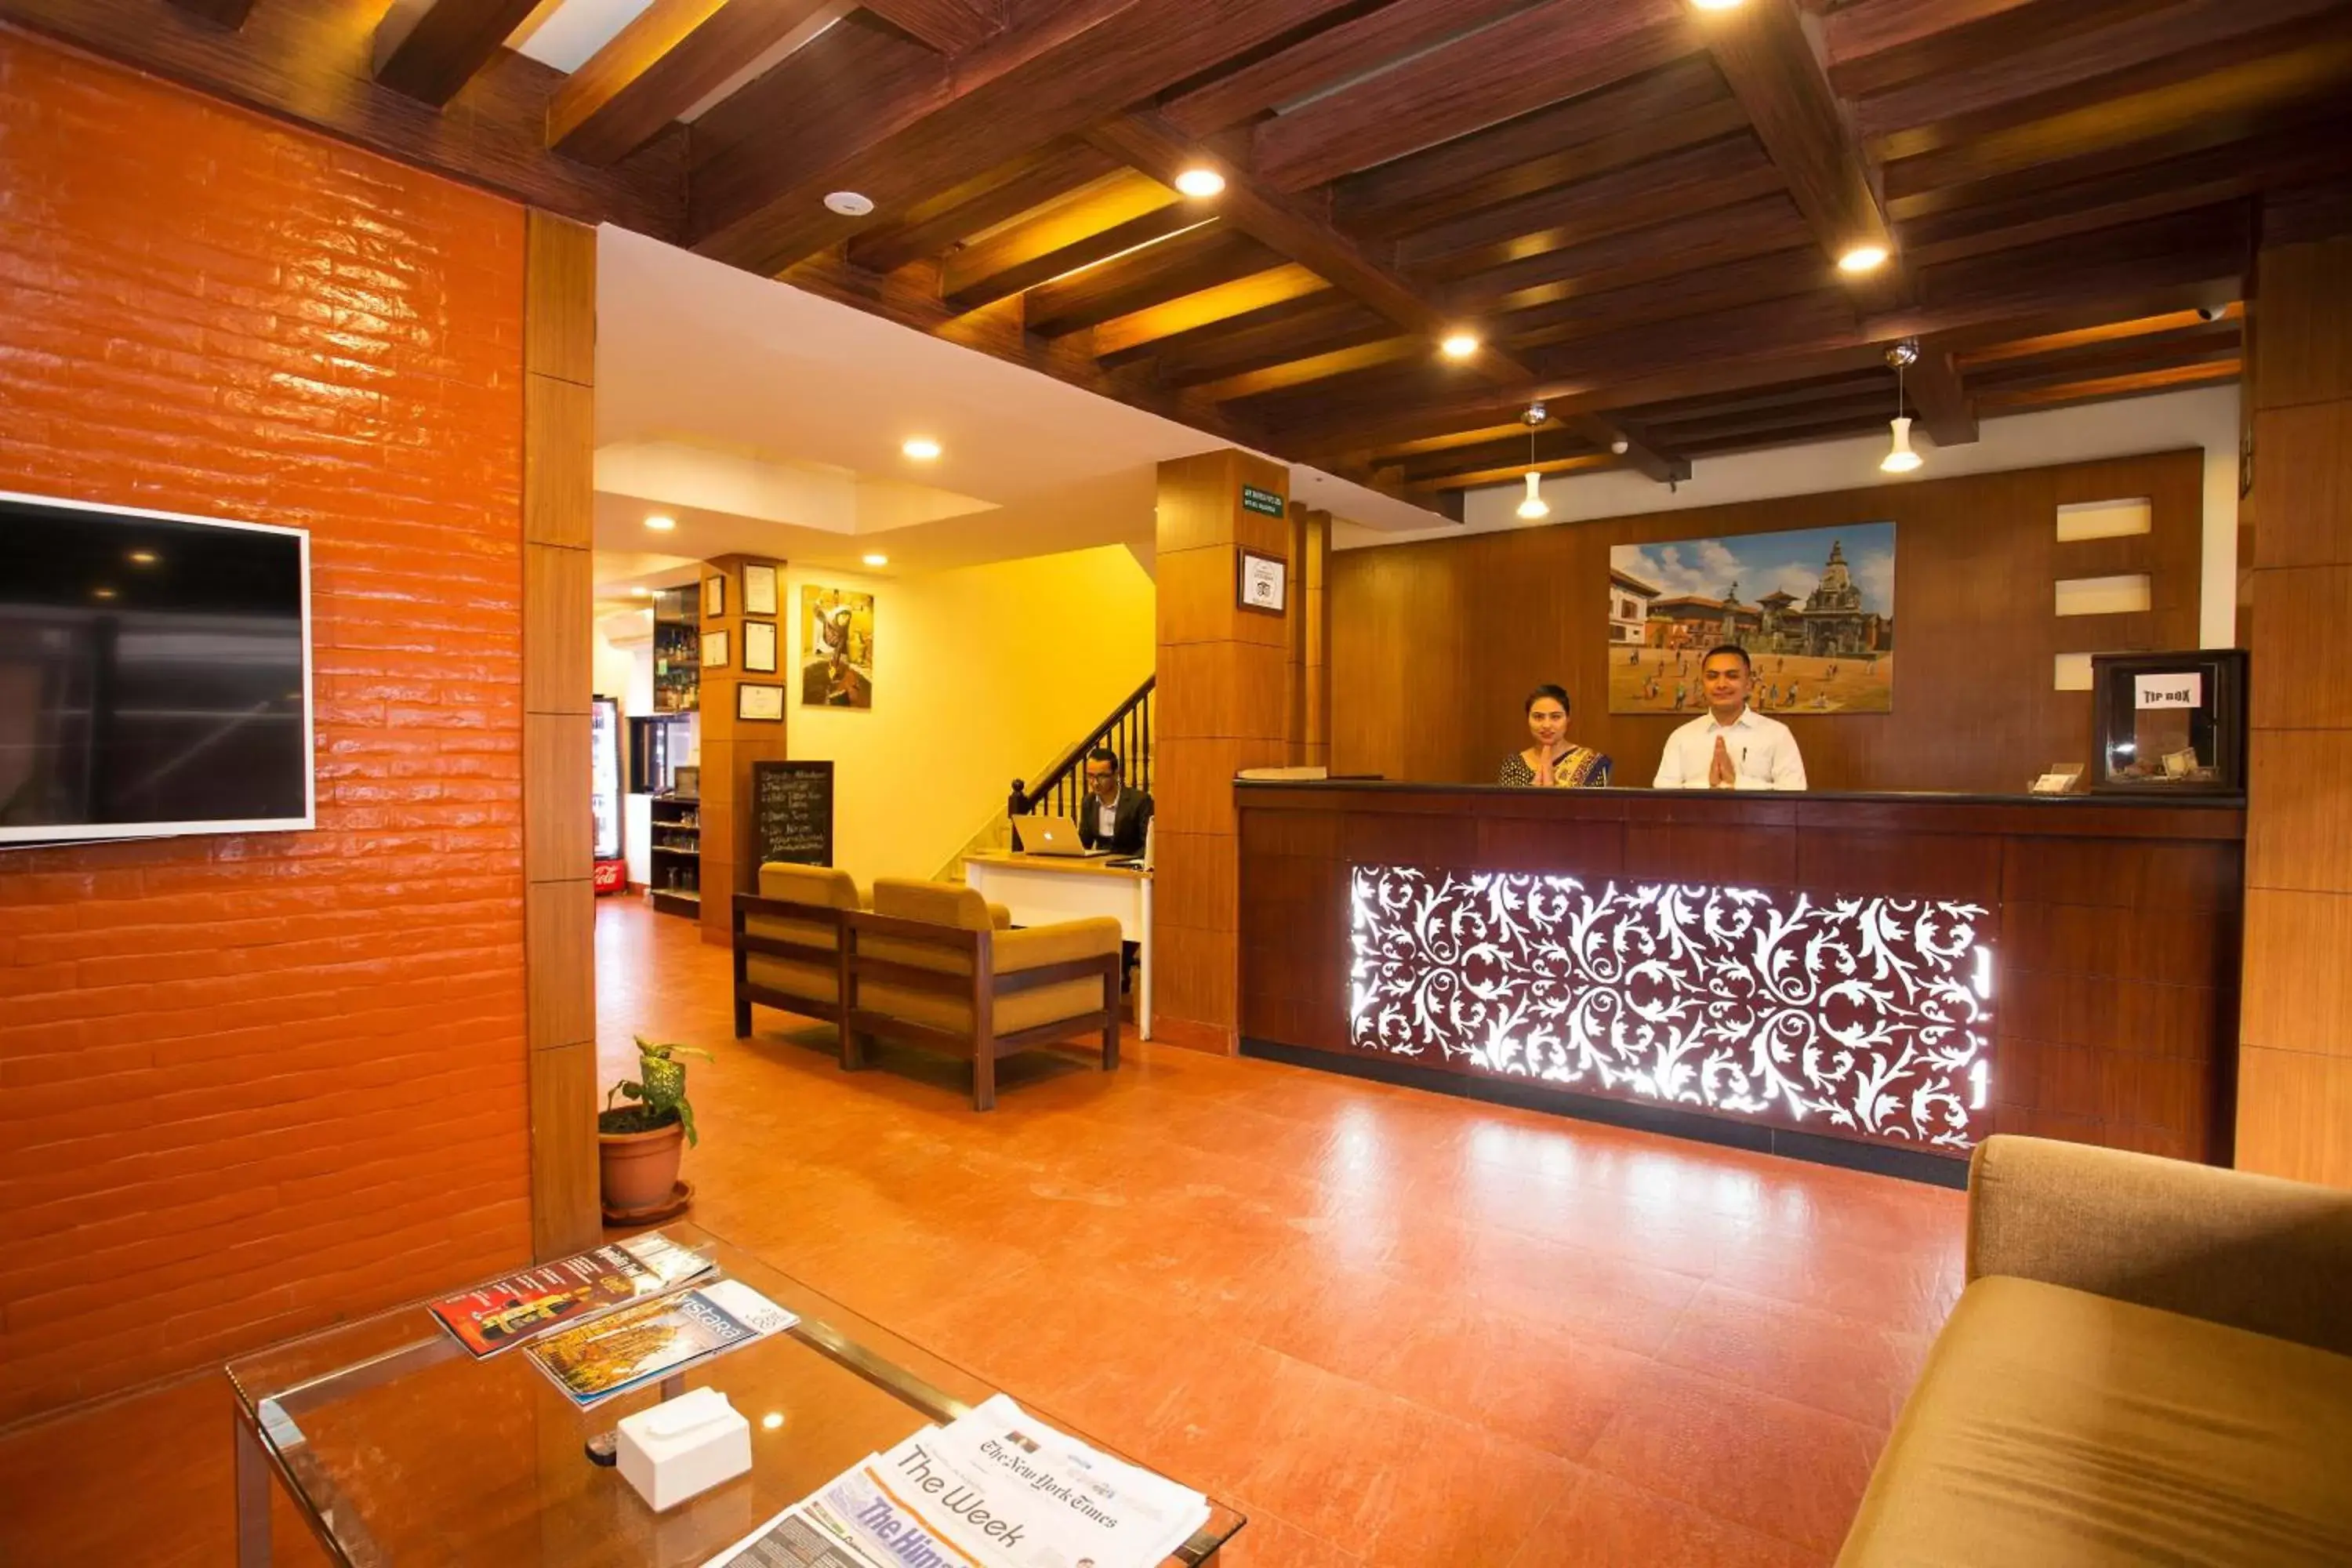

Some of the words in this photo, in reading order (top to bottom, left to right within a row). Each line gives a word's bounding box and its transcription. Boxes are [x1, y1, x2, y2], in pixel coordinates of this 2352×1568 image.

[2144, 690, 2163, 703] TIP
[2165, 689, 2190, 703] BOX
[898, 1443, 945, 1494] The
[942, 1485, 1025, 1548] Week
[980, 1439, 1010, 1466] The
[1004, 1456, 1037, 1479] New
[1030, 1474, 1073, 1503] York
[1070, 1494, 1118, 1528] Times
[858, 1495, 902, 1539] The
